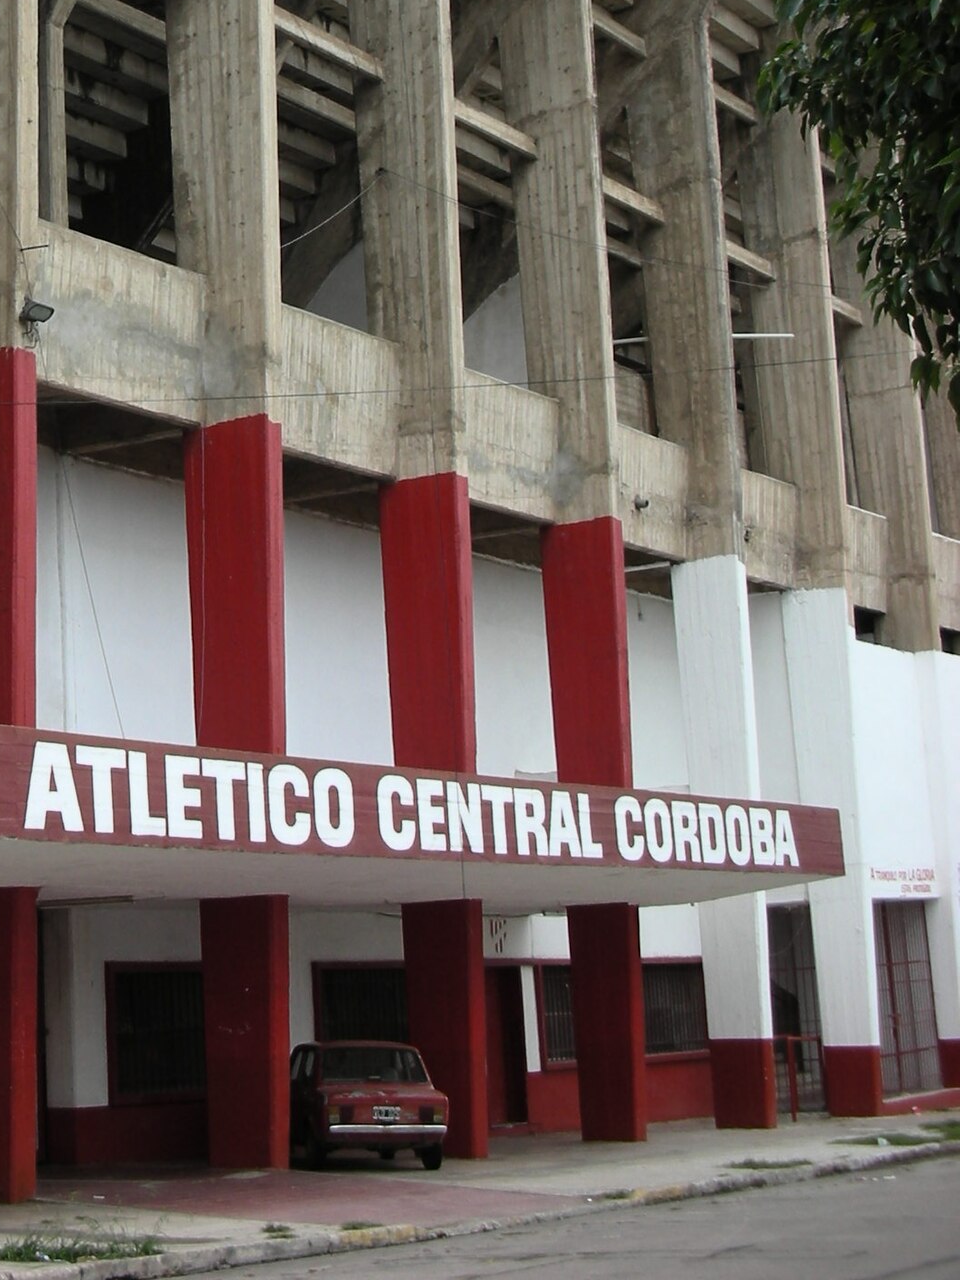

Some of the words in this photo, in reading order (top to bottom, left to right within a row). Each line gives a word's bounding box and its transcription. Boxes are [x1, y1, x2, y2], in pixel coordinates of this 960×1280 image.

[24, 741, 356, 849] ATLETICO
[376, 774, 603, 860] CENTRAL
[614, 795, 801, 867] CORDOBA
